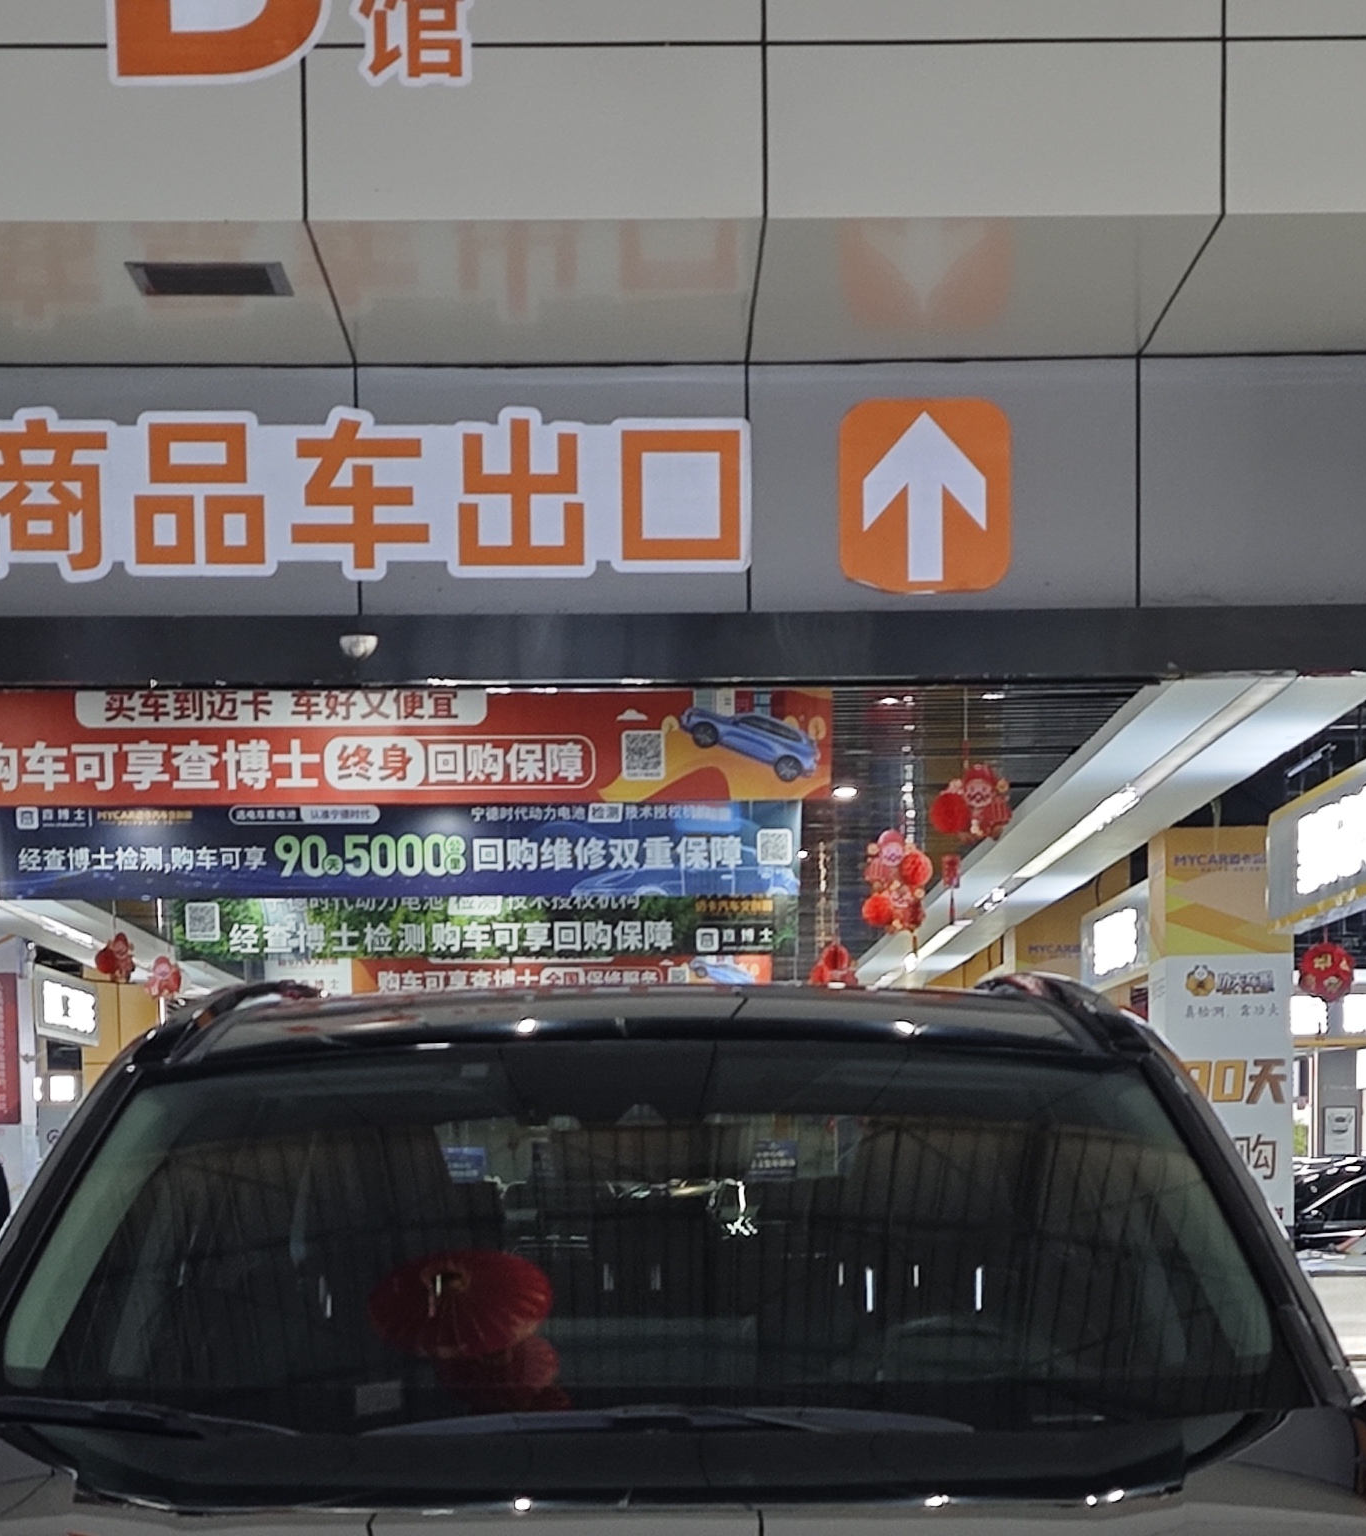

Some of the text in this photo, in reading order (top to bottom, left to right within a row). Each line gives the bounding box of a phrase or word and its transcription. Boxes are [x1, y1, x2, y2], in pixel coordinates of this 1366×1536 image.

[104, 689, 459, 722] 买车到迈卡 车好又便宜
[472, 835, 743, 873] 回购维修双重保障
